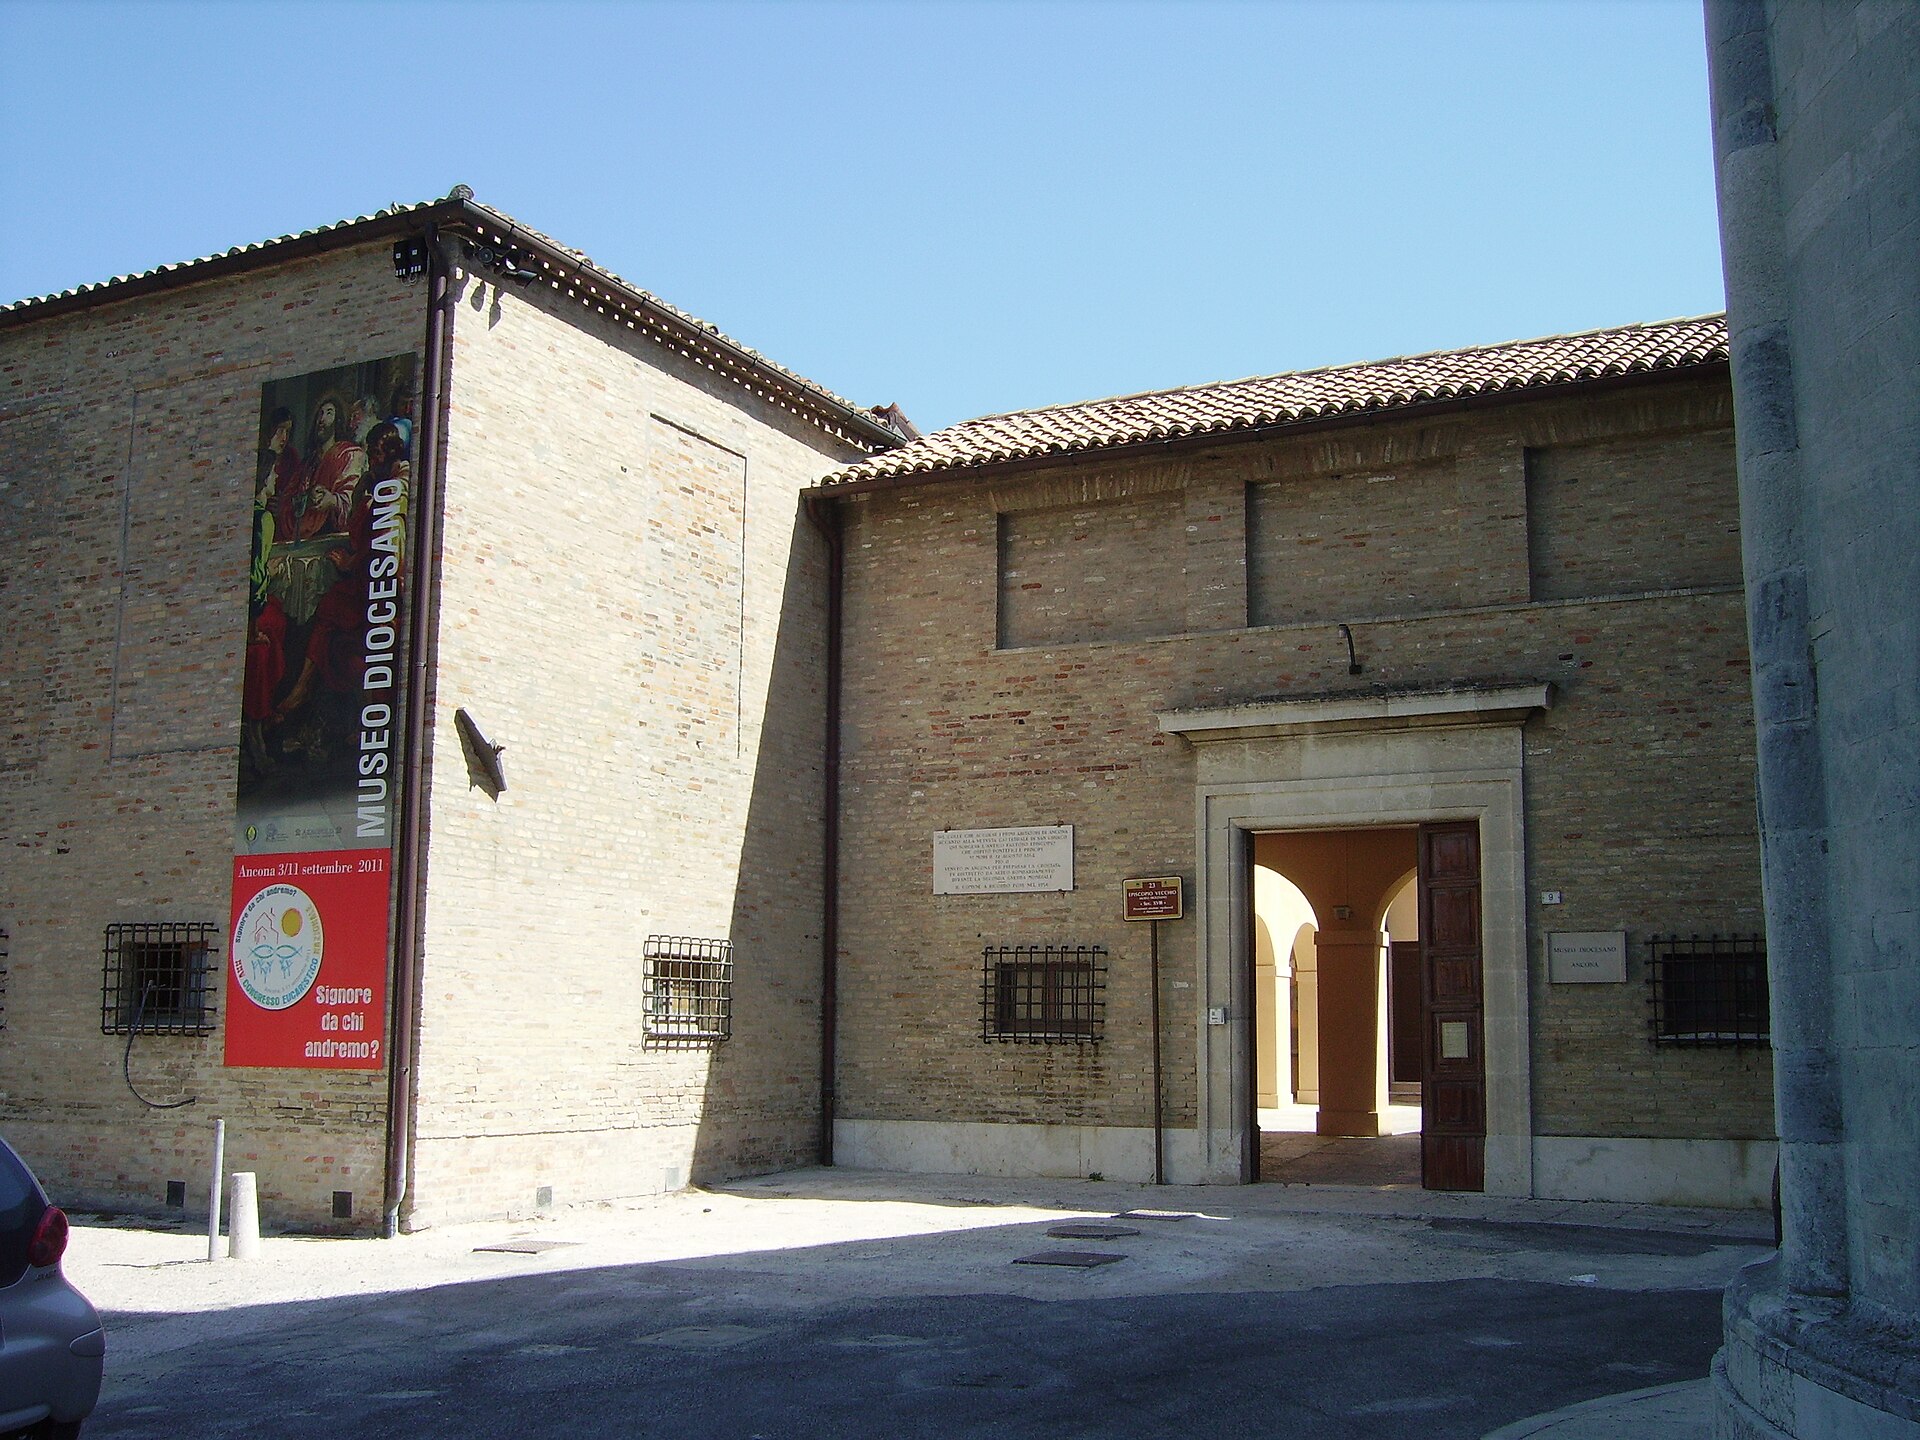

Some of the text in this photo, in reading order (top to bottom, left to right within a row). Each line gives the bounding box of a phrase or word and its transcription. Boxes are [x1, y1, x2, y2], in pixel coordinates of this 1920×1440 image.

[356, 478, 401, 838] MUSEO DIOCESANO
[238, 858, 384, 878] Ancona 3/11 settembre 2011
[266, 886, 297, 897] andremo?
[1548, 893, 1554, 901] 9
[316, 984, 372, 1006] Signore
[321, 1012, 364, 1031] da chi
[305, 1039, 380, 1059] andremo?
